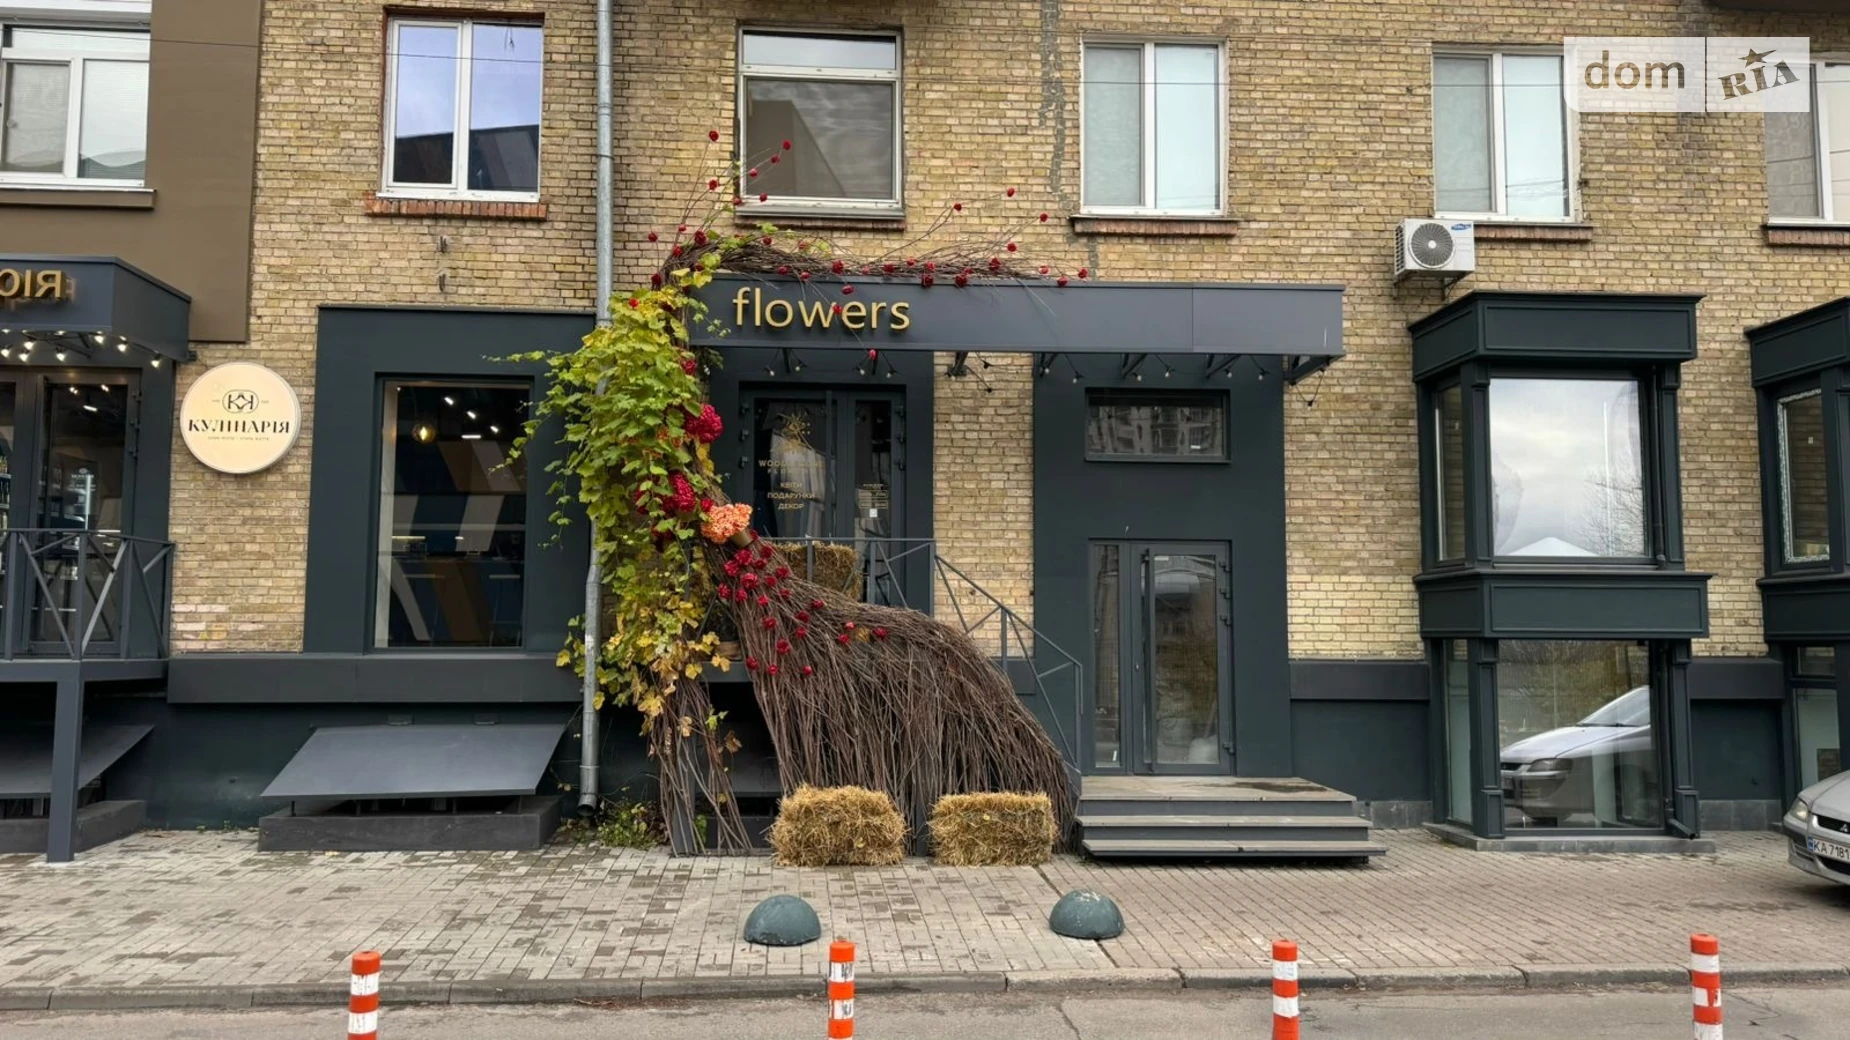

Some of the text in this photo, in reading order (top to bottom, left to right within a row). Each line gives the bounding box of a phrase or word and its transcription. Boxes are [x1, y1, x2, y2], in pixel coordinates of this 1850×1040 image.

[732, 286, 911, 331] flowers
[188, 418, 290, 434] КУЛІНАРІЯ
[767, 491, 816, 501] ПОДАРУНКИ
[777, 503, 805, 512] ДЕКОР
